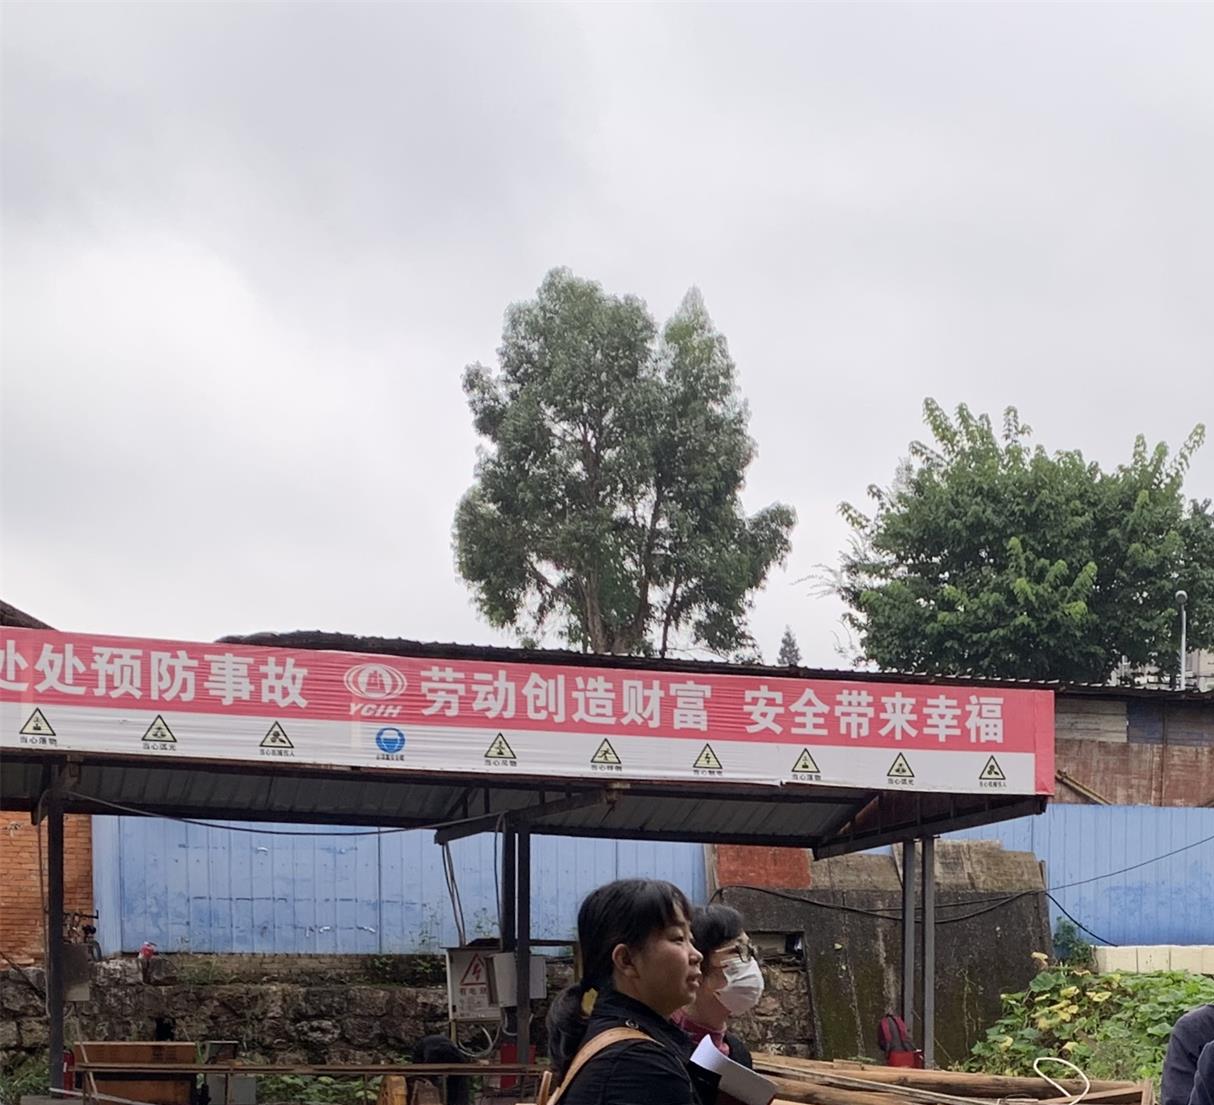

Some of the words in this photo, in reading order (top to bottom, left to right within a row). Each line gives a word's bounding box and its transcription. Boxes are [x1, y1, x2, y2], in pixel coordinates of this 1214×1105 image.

[0, 639, 309, 708] 处处预防事故
[420, 666, 712, 731] 劳动创造财富
[743, 685, 1004, 744] 安全带来幸福
